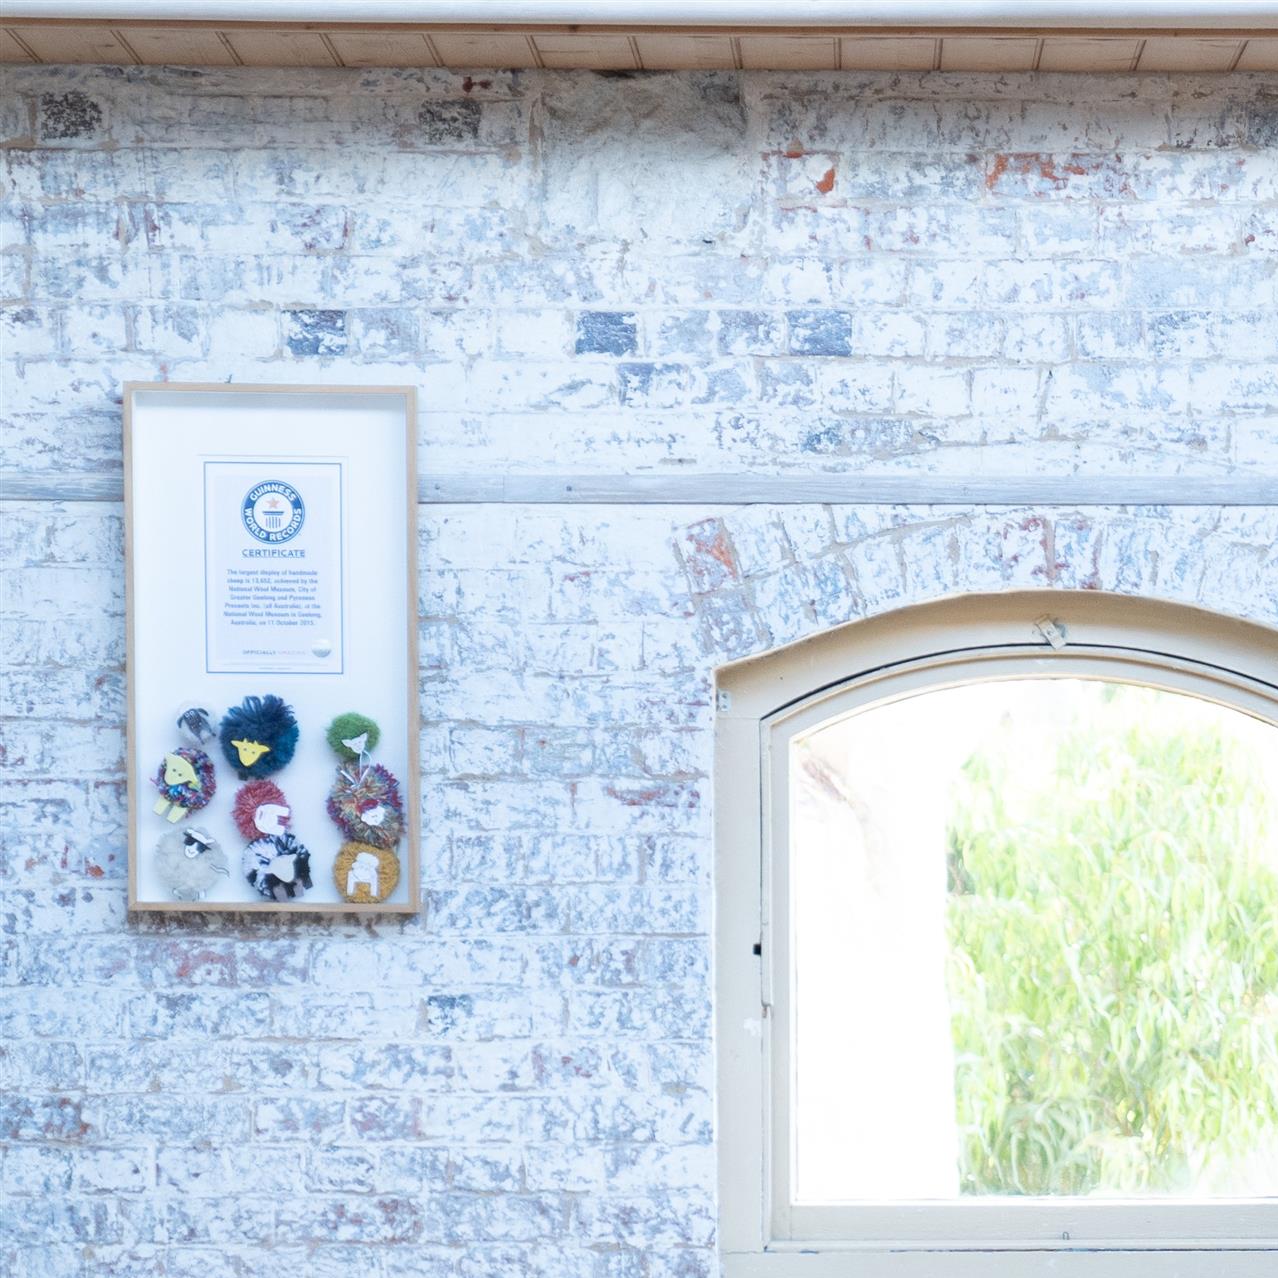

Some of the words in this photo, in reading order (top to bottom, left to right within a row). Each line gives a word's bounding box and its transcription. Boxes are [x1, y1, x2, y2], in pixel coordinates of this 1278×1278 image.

[249, 483, 297, 501] GUINNESS
[244, 507, 266, 539] WORLD
[269, 508, 302, 541] RECORDS
[241, 549, 305, 558] CERTIFICATE
[227, 569, 237, 577] The
[239, 569, 258, 577] largest
[260, 569, 280, 577] display
[289, 569, 318, 577] handmade
